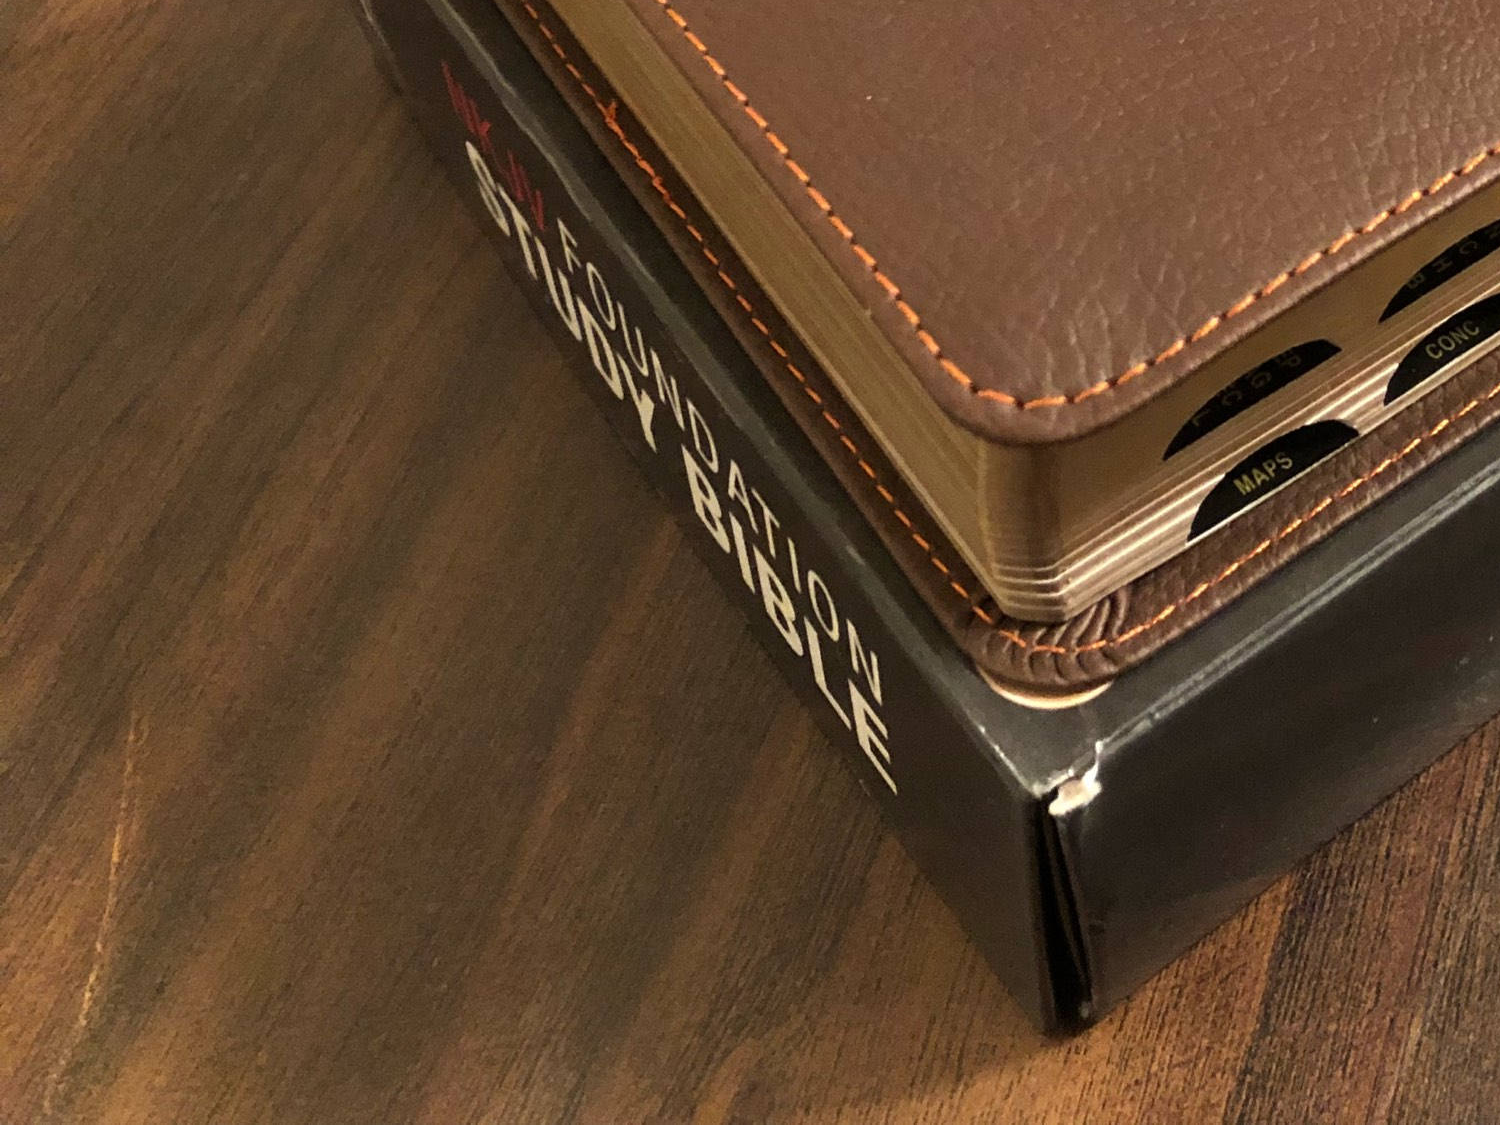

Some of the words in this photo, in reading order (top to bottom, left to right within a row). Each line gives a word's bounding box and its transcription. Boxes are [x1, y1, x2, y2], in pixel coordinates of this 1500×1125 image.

[465, 140, 657, 453] STUDY
[681, 444, 898, 796] BIBLE
[556, 216, 884, 706] FOUNDATION
[1232, 450, 1294, 497] MAPS
[1424, 319, 1481, 361] CONC
